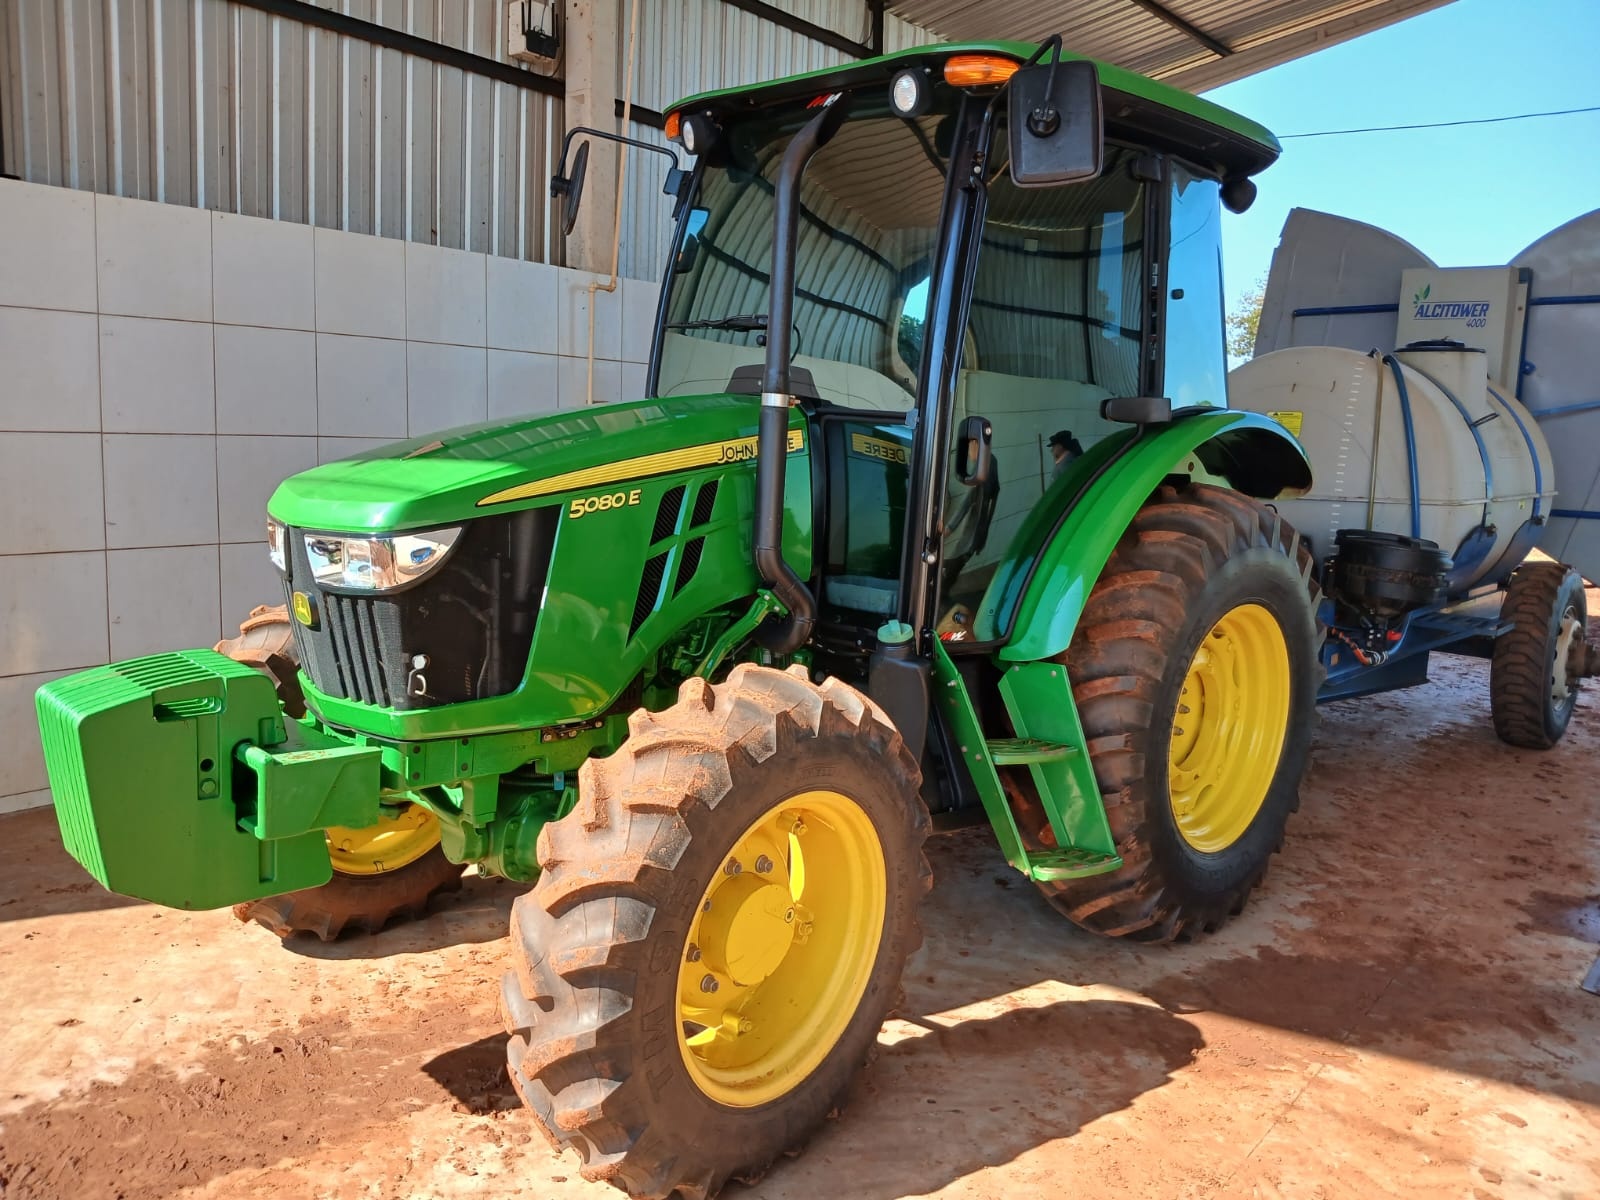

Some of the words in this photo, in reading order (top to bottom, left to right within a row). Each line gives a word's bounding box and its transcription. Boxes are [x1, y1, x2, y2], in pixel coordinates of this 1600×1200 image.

[1414, 303, 1490, 318] ALCITOWER
[1465, 318, 1487, 328] 4000
[718, 443, 754, 461] JOHN
[569, 492, 626, 519] 5080
[628, 489, 642, 505] E
